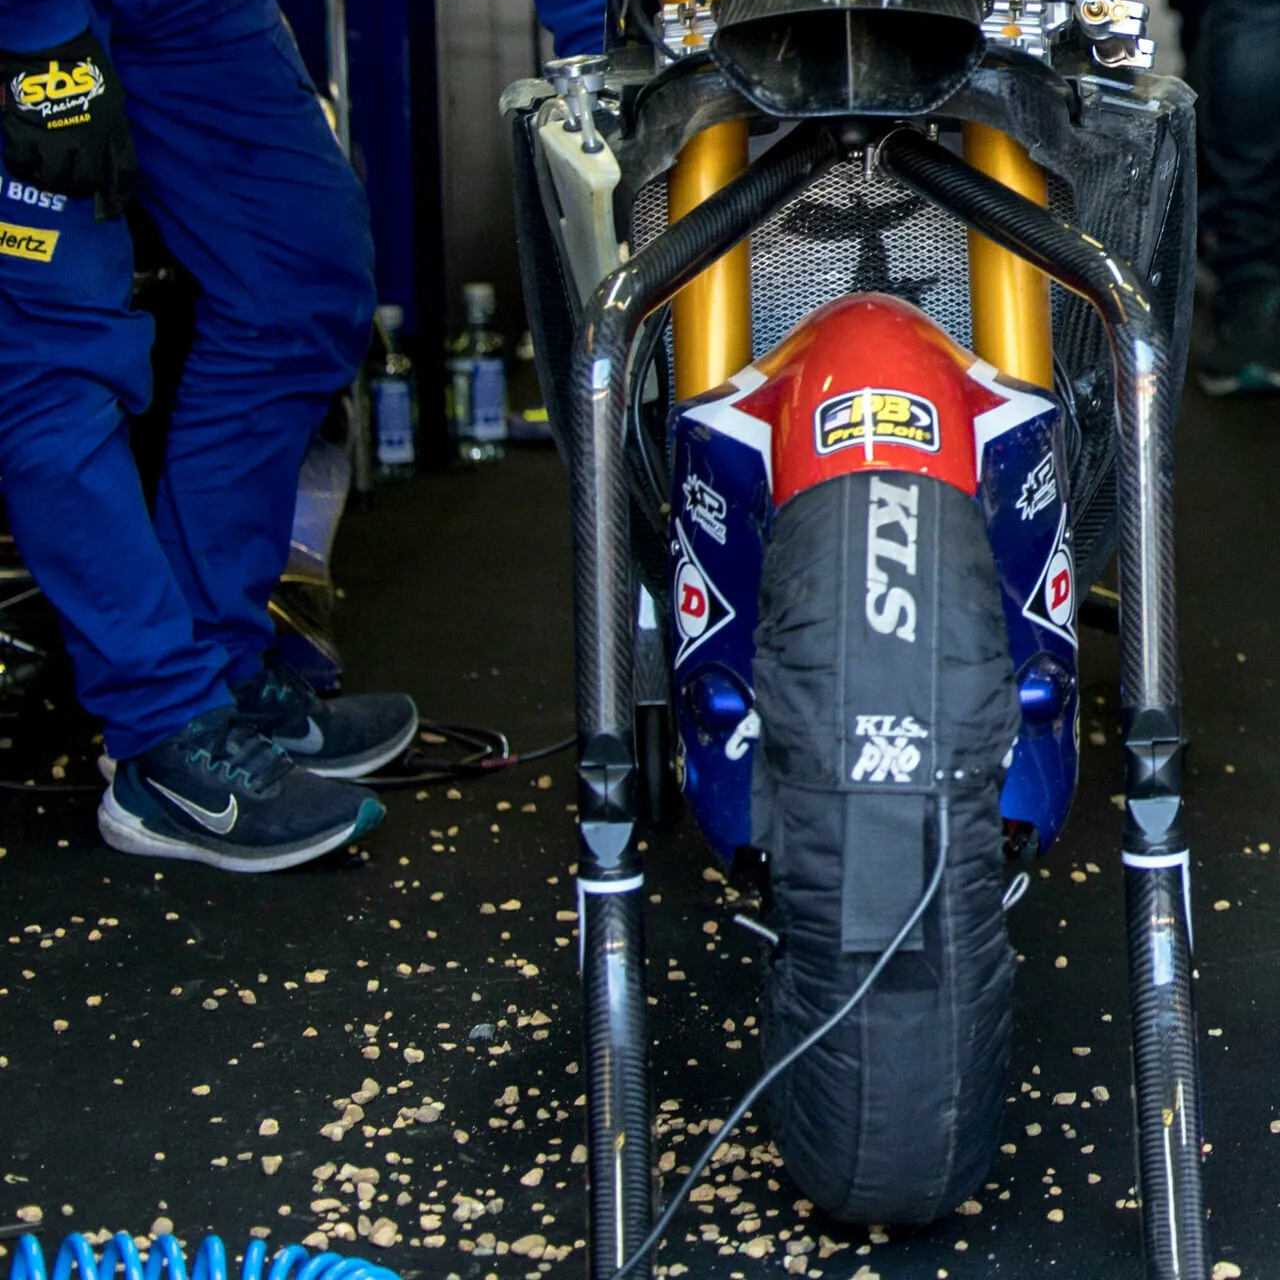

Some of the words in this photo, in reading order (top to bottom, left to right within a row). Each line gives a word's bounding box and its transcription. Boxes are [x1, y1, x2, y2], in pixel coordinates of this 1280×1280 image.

[21, 60, 97, 104] sbs
[38, 95, 90, 117] Racing
[7, 181, 68, 212] BOSS
[850, 394, 911, 424] PB
[866, 476, 919, 643] KLS
[680, 582, 706, 618] D
[1050, 568, 1070, 611] D
